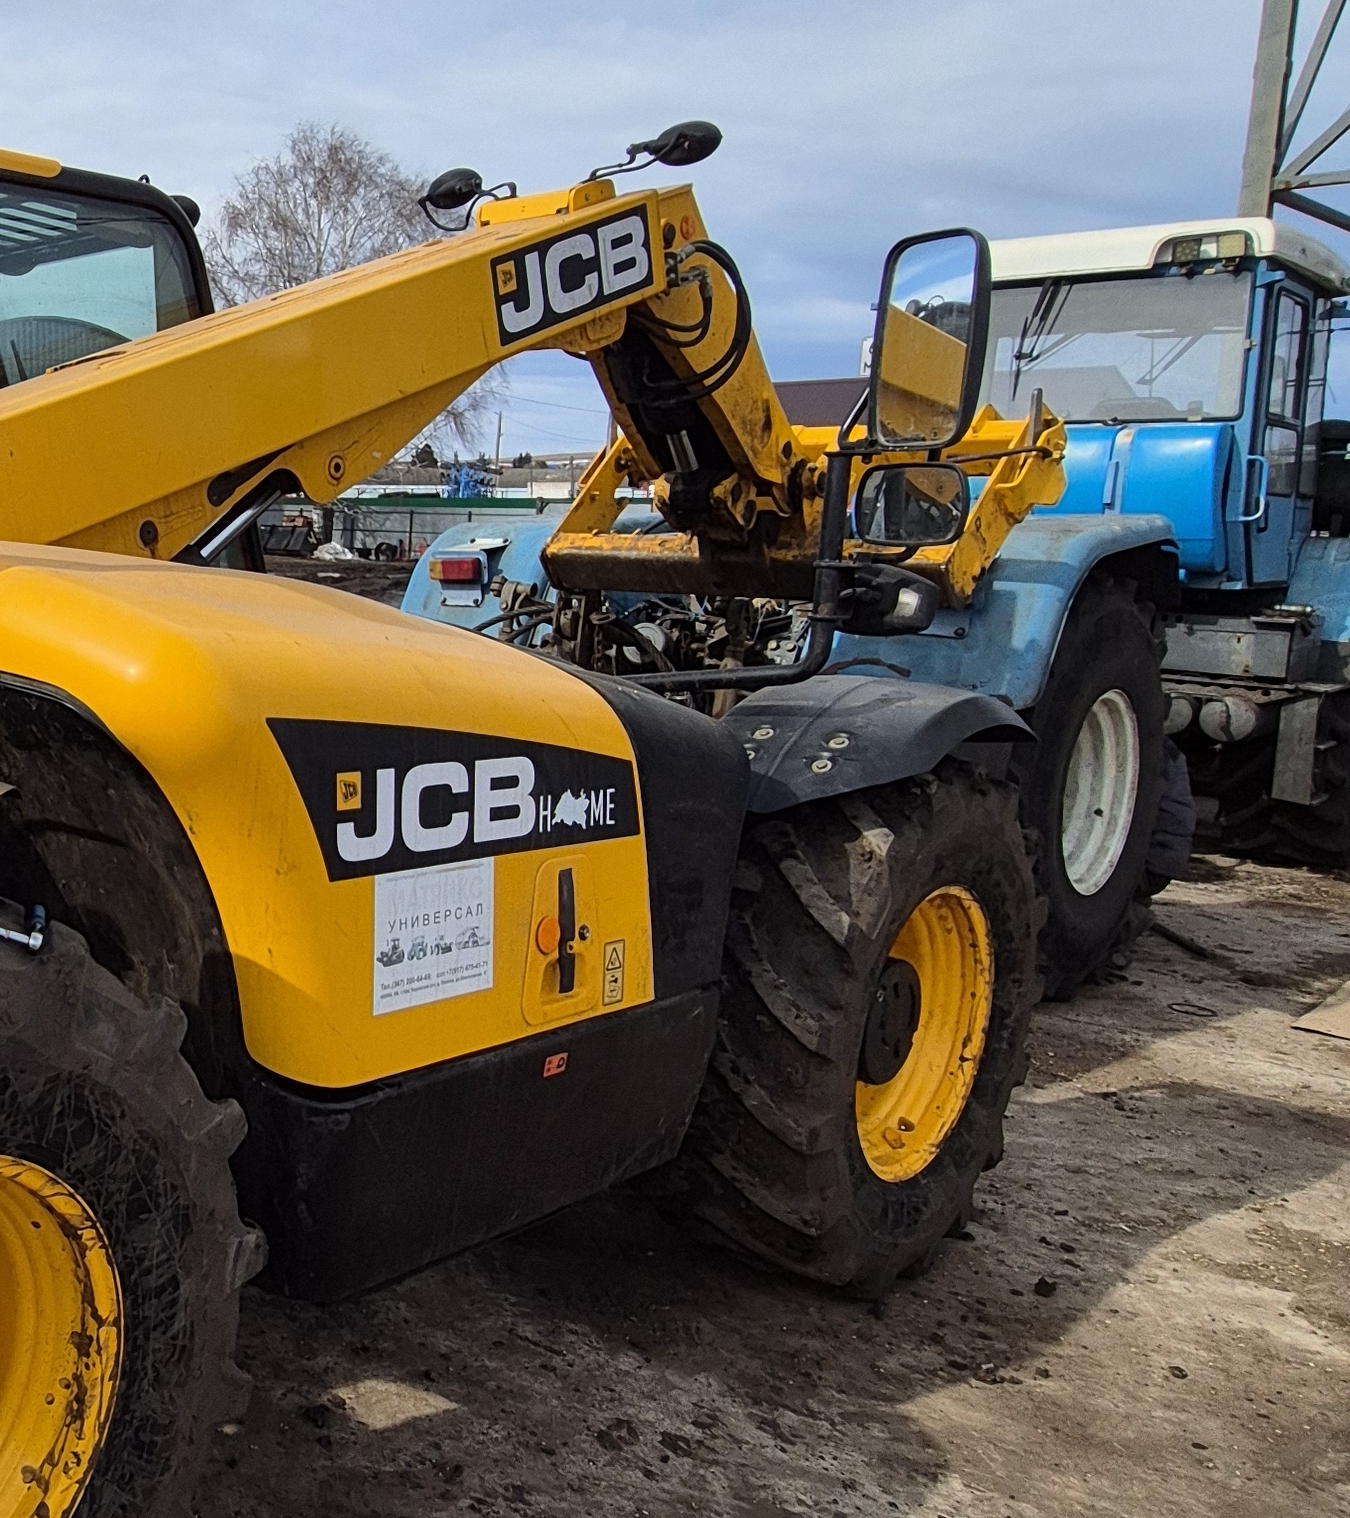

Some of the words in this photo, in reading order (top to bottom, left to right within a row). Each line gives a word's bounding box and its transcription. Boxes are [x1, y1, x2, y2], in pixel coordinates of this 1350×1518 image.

[501, 216, 649, 333] JCB
[337, 757, 535, 862] JCB
[343, 782, 358, 800] JCB
[388, 903, 484, 934] УНИВЕРСАЛ
